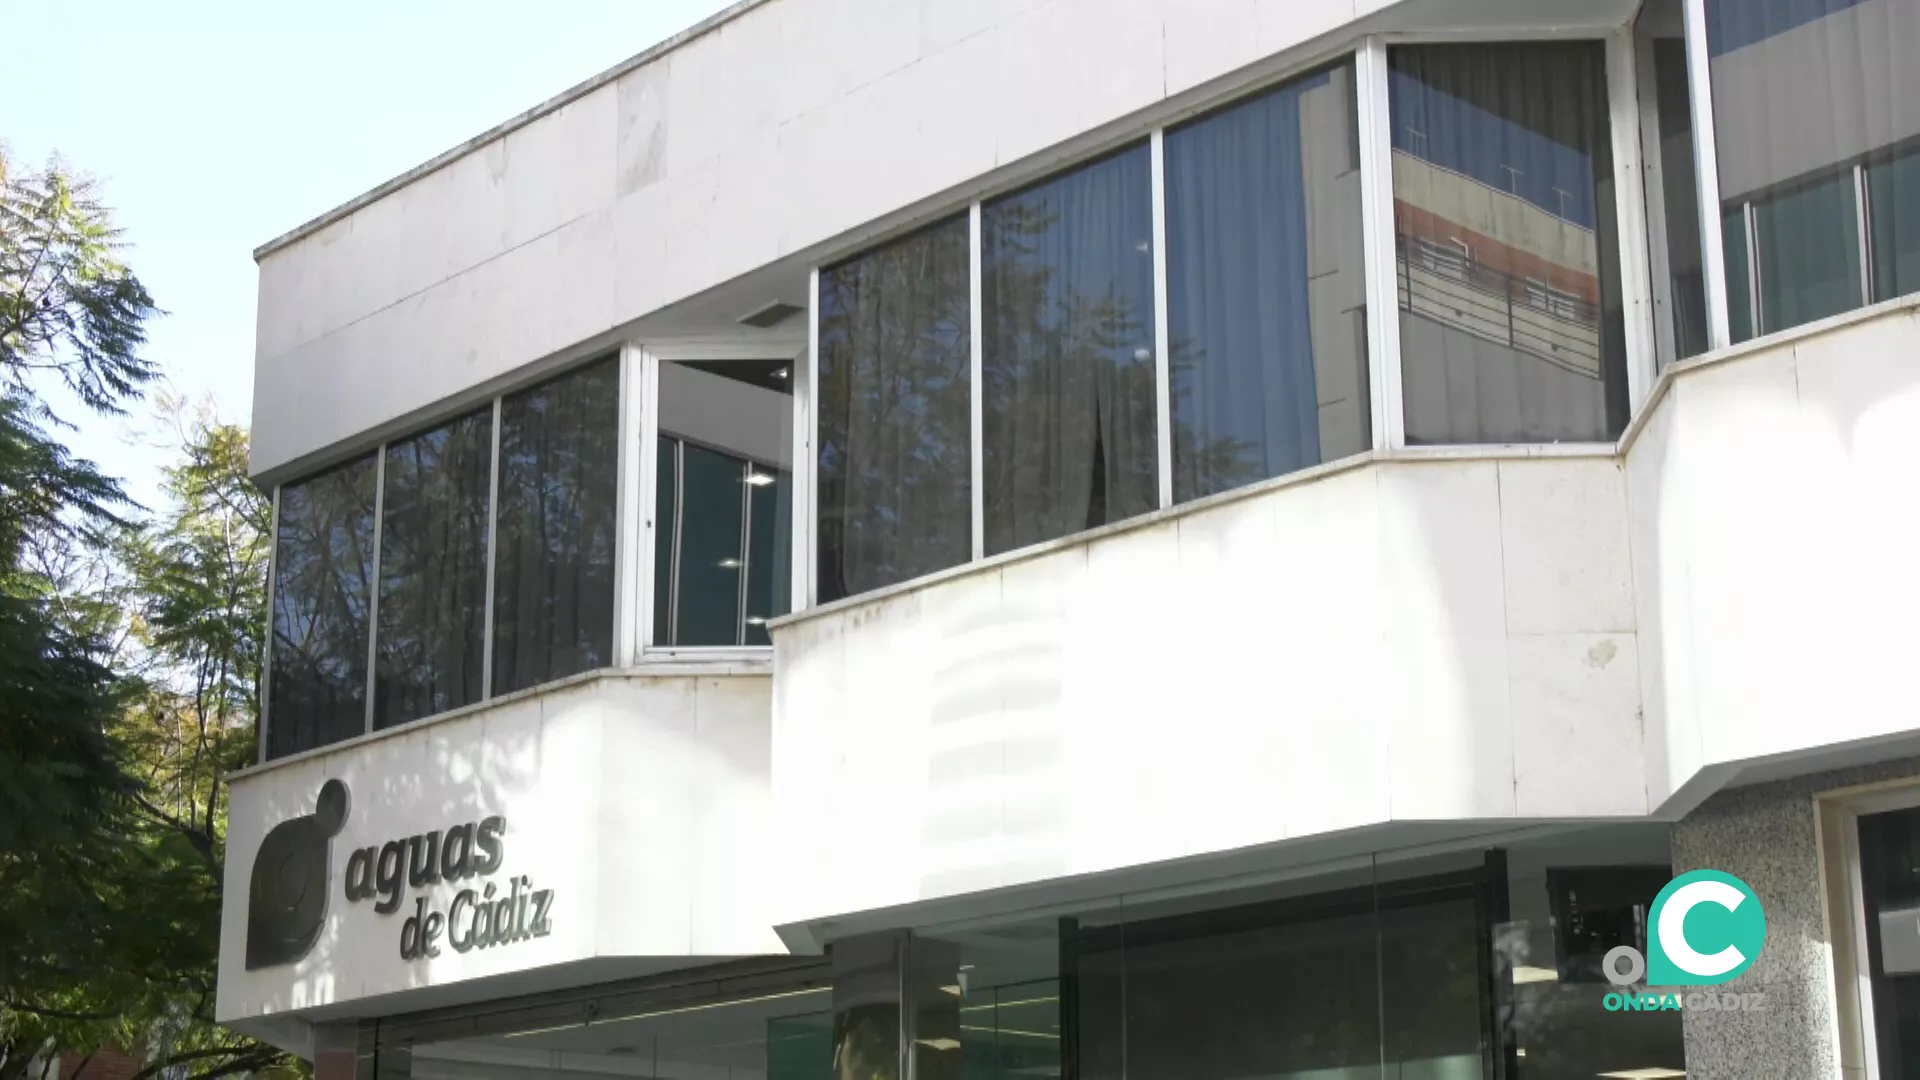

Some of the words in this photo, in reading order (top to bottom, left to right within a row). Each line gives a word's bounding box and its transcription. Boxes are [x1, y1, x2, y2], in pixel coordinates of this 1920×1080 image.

[345, 816, 506, 913] aguas
[400, 897, 444, 960] de
[449, 875, 554, 953] Cádiz
